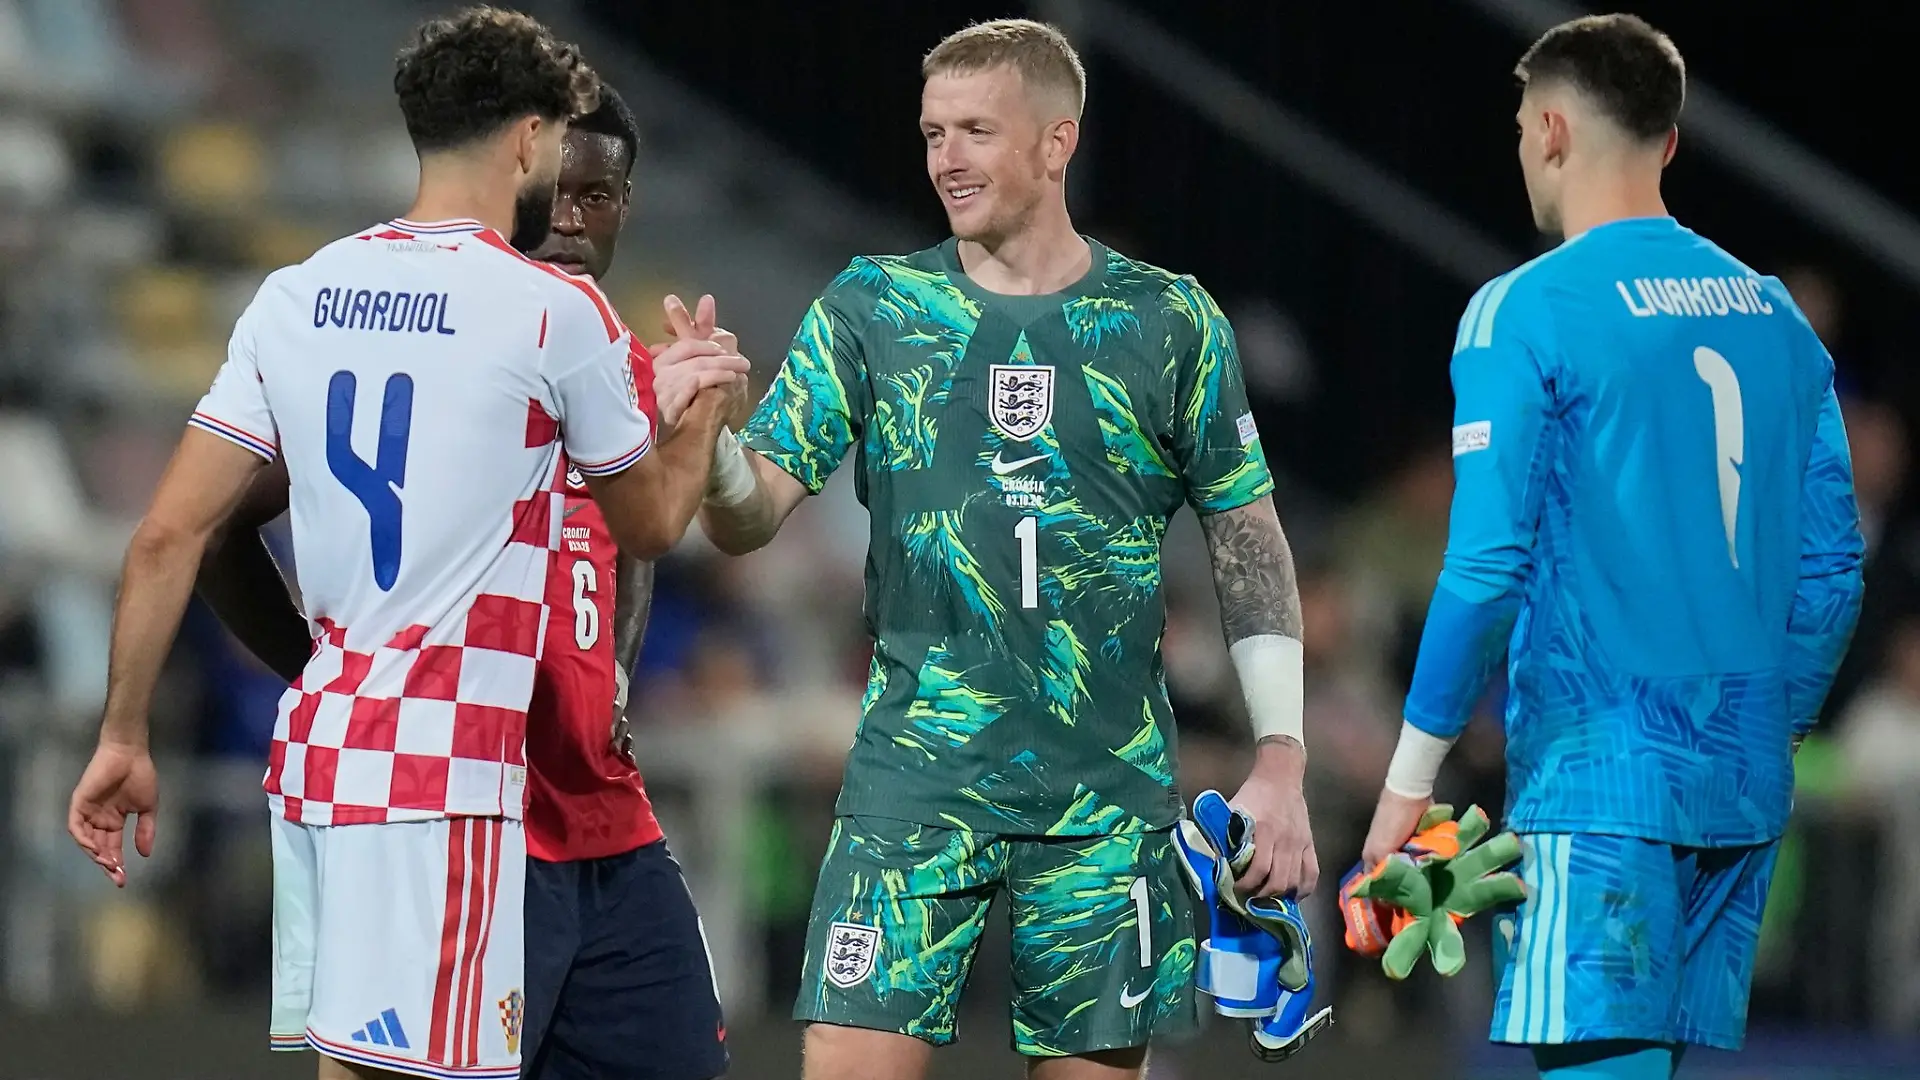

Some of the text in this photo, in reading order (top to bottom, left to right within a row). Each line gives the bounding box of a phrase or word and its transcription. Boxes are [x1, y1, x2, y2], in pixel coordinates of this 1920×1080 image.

[314, 287, 456, 335] GVARDIOL
[326, 370, 414, 592] 4
[1002, 480, 1045, 493] CROATIA
[1693, 346, 1744, 568] 1
[562, 527, 591, 539] CROATIA
[1014, 516, 1039, 608] 1
[571, 560, 599, 651] 6
[1129, 876, 1151, 968] 1
